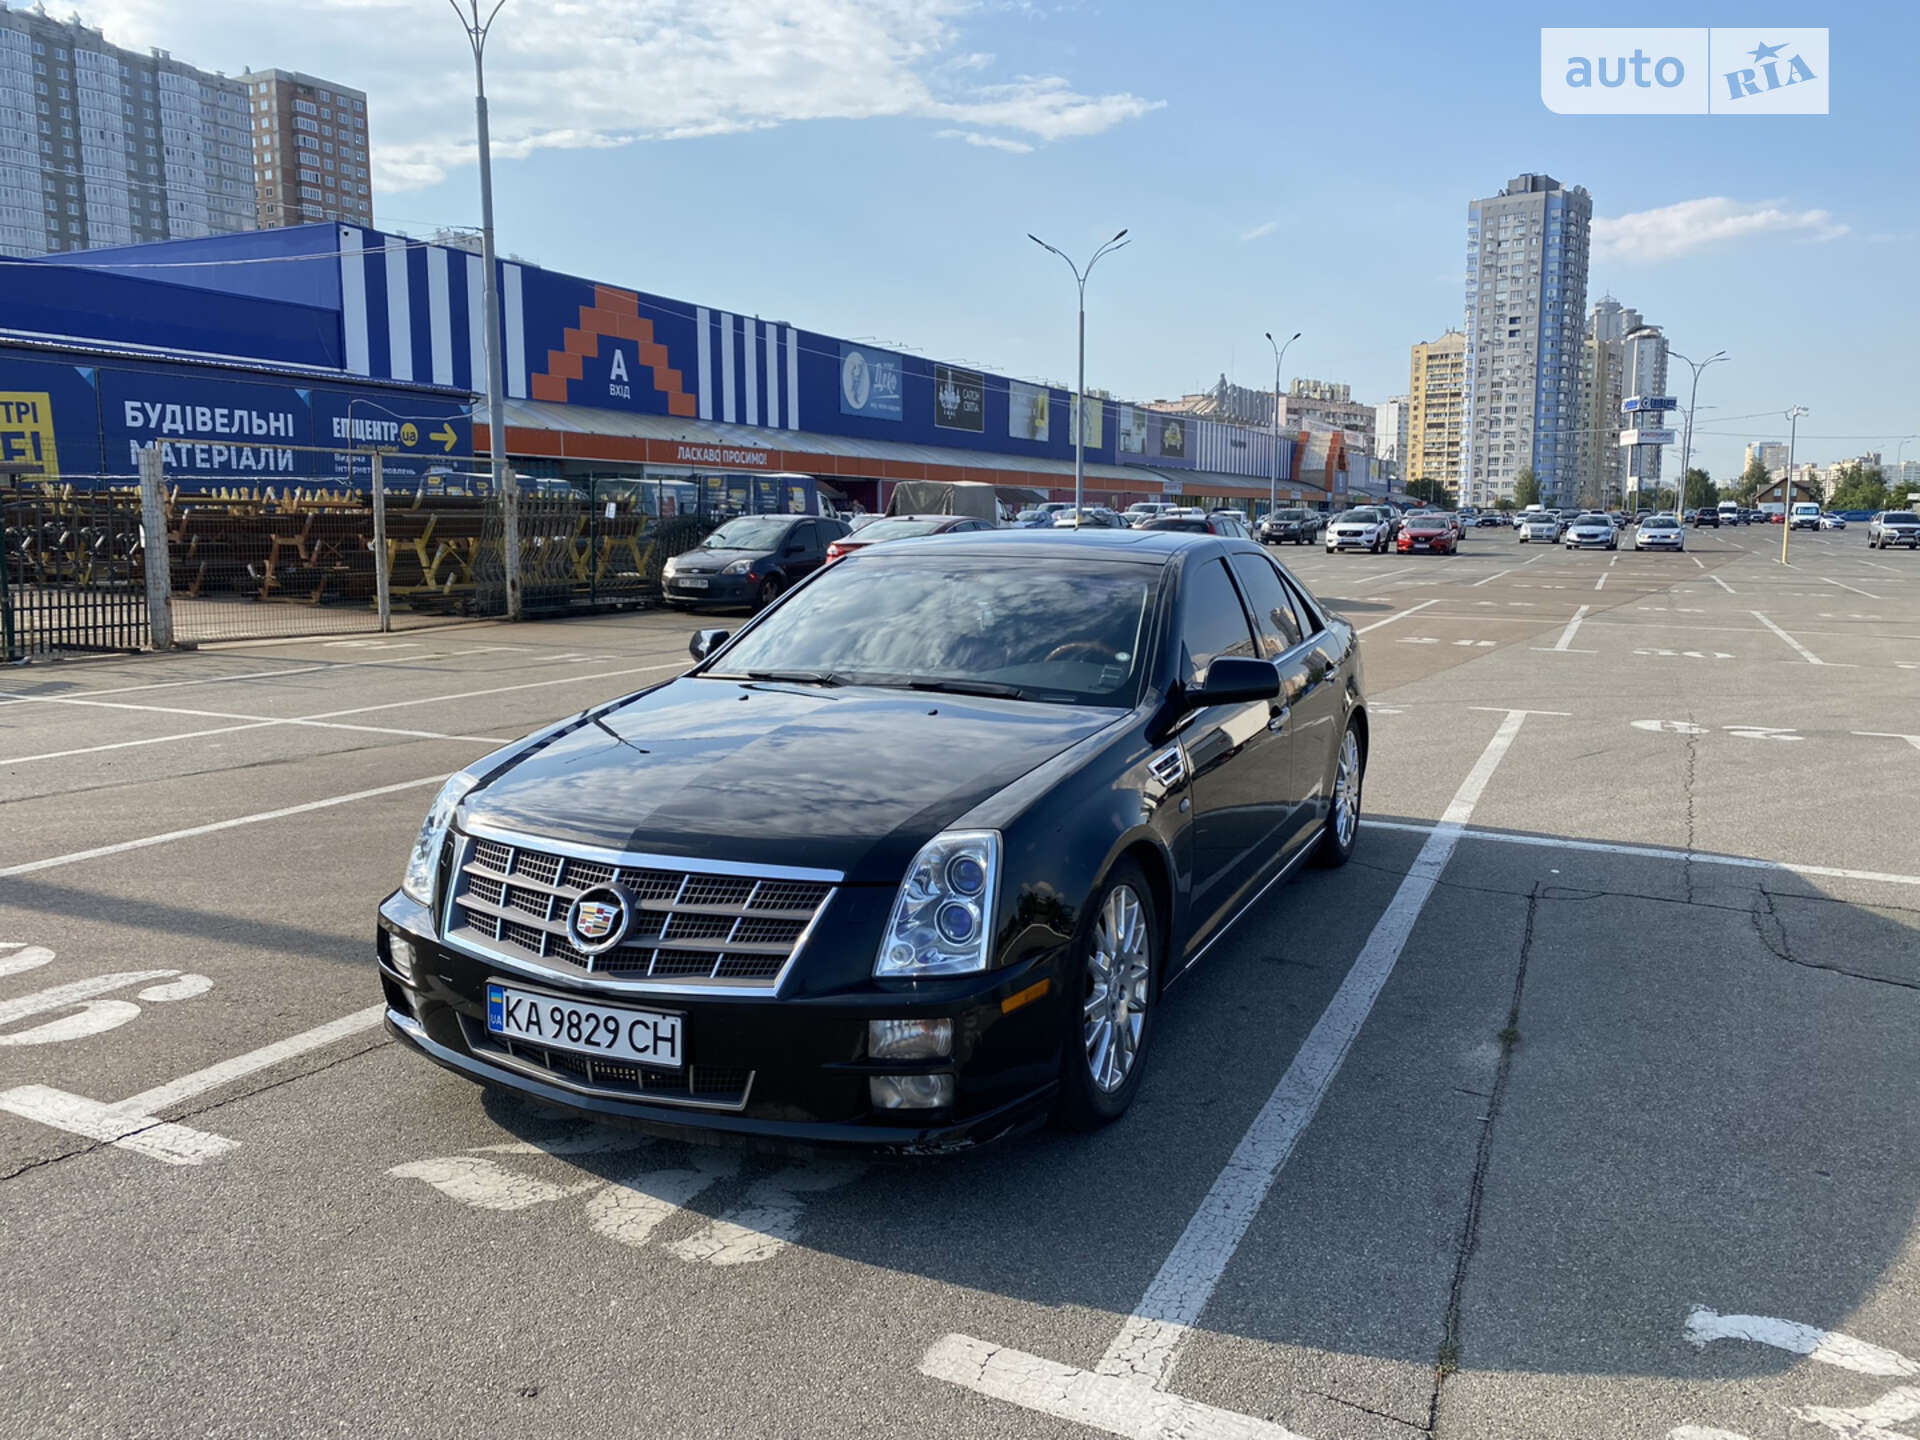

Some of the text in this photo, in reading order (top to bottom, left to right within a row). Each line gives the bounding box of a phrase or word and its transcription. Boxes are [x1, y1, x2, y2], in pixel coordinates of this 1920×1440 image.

[610, 348, 629, 382] А
[609, 383, 631, 400] ВХІД
[124, 400, 294, 437] БУДІВЕЛЬНІ
[677, 446, 768, 465] ЛАСКАВО ПРОСИМО!
[504, 995, 676, 1058] KA 9829 CH
